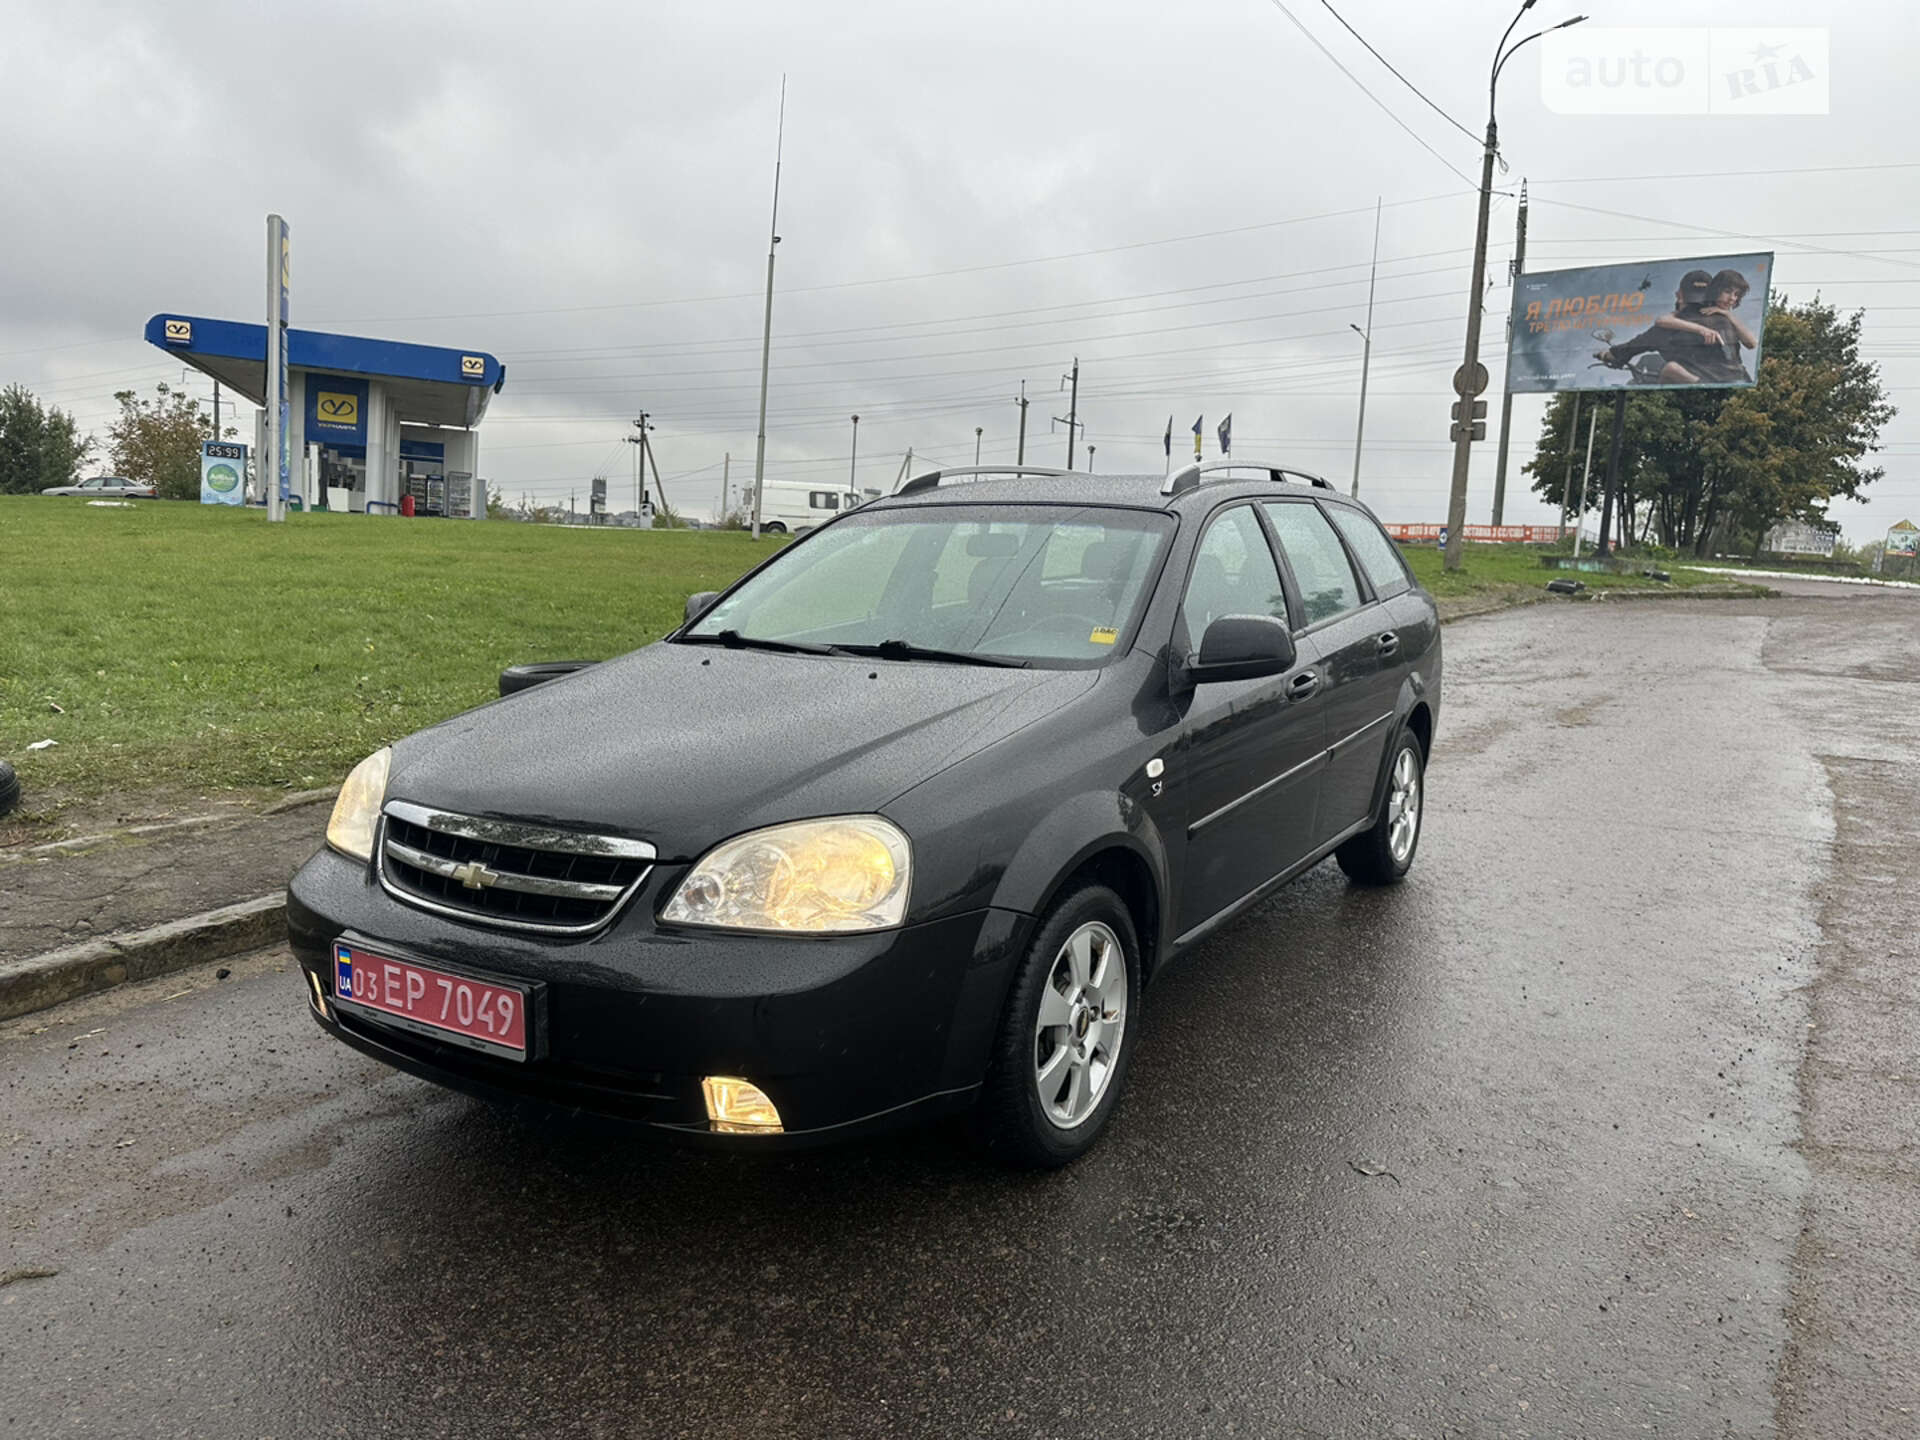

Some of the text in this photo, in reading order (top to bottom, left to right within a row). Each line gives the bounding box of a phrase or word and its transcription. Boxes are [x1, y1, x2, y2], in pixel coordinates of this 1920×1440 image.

[1525, 291, 1645, 320] Я ЛЮБЛЮ
[339, 975, 352, 993] UA
[353, 964, 514, 1036] 03 EP 7049
